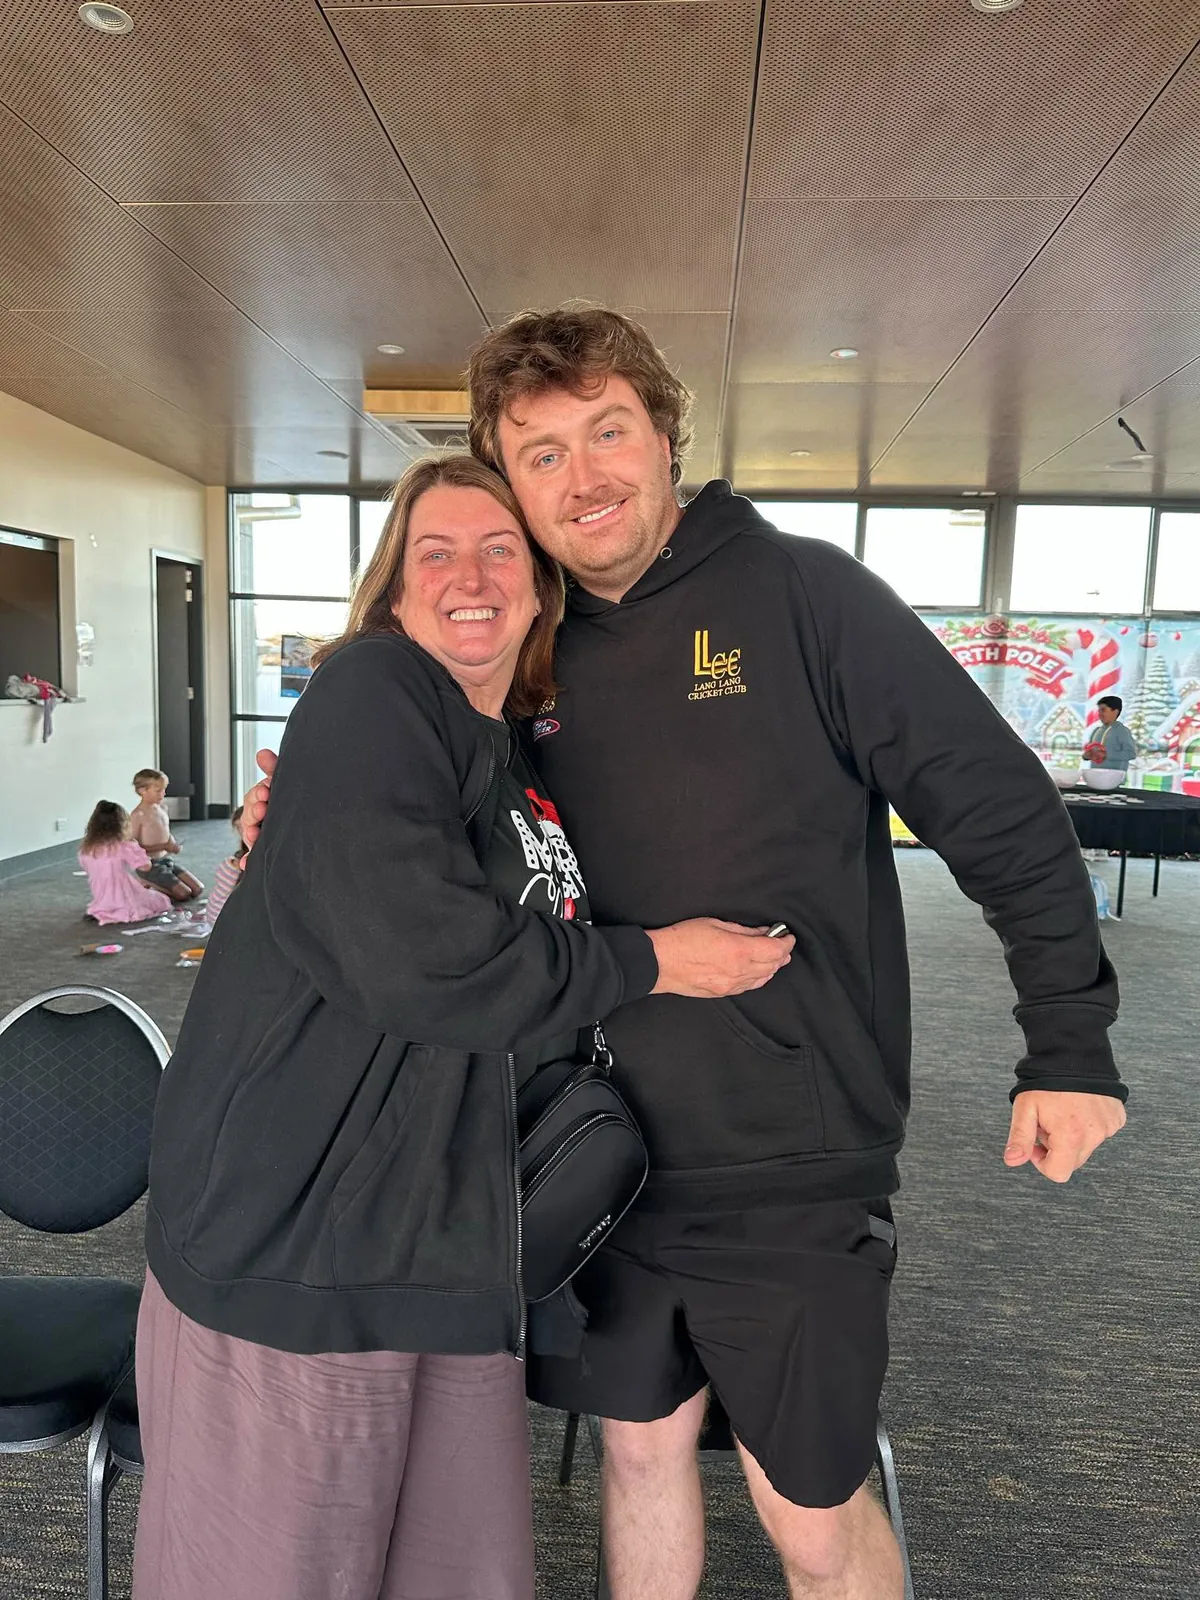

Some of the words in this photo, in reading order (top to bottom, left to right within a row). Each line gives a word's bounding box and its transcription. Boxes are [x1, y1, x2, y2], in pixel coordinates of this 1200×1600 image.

[955, 647, 1000, 663] RTH
[1005, 649, 1060, 673] POLE
[687, 688, 724, 701] CRICKET
[724, 684, 747, 696] CLUB
[694, 680, 717, 692] LANG
[718, 676, 741, 688] LANG
